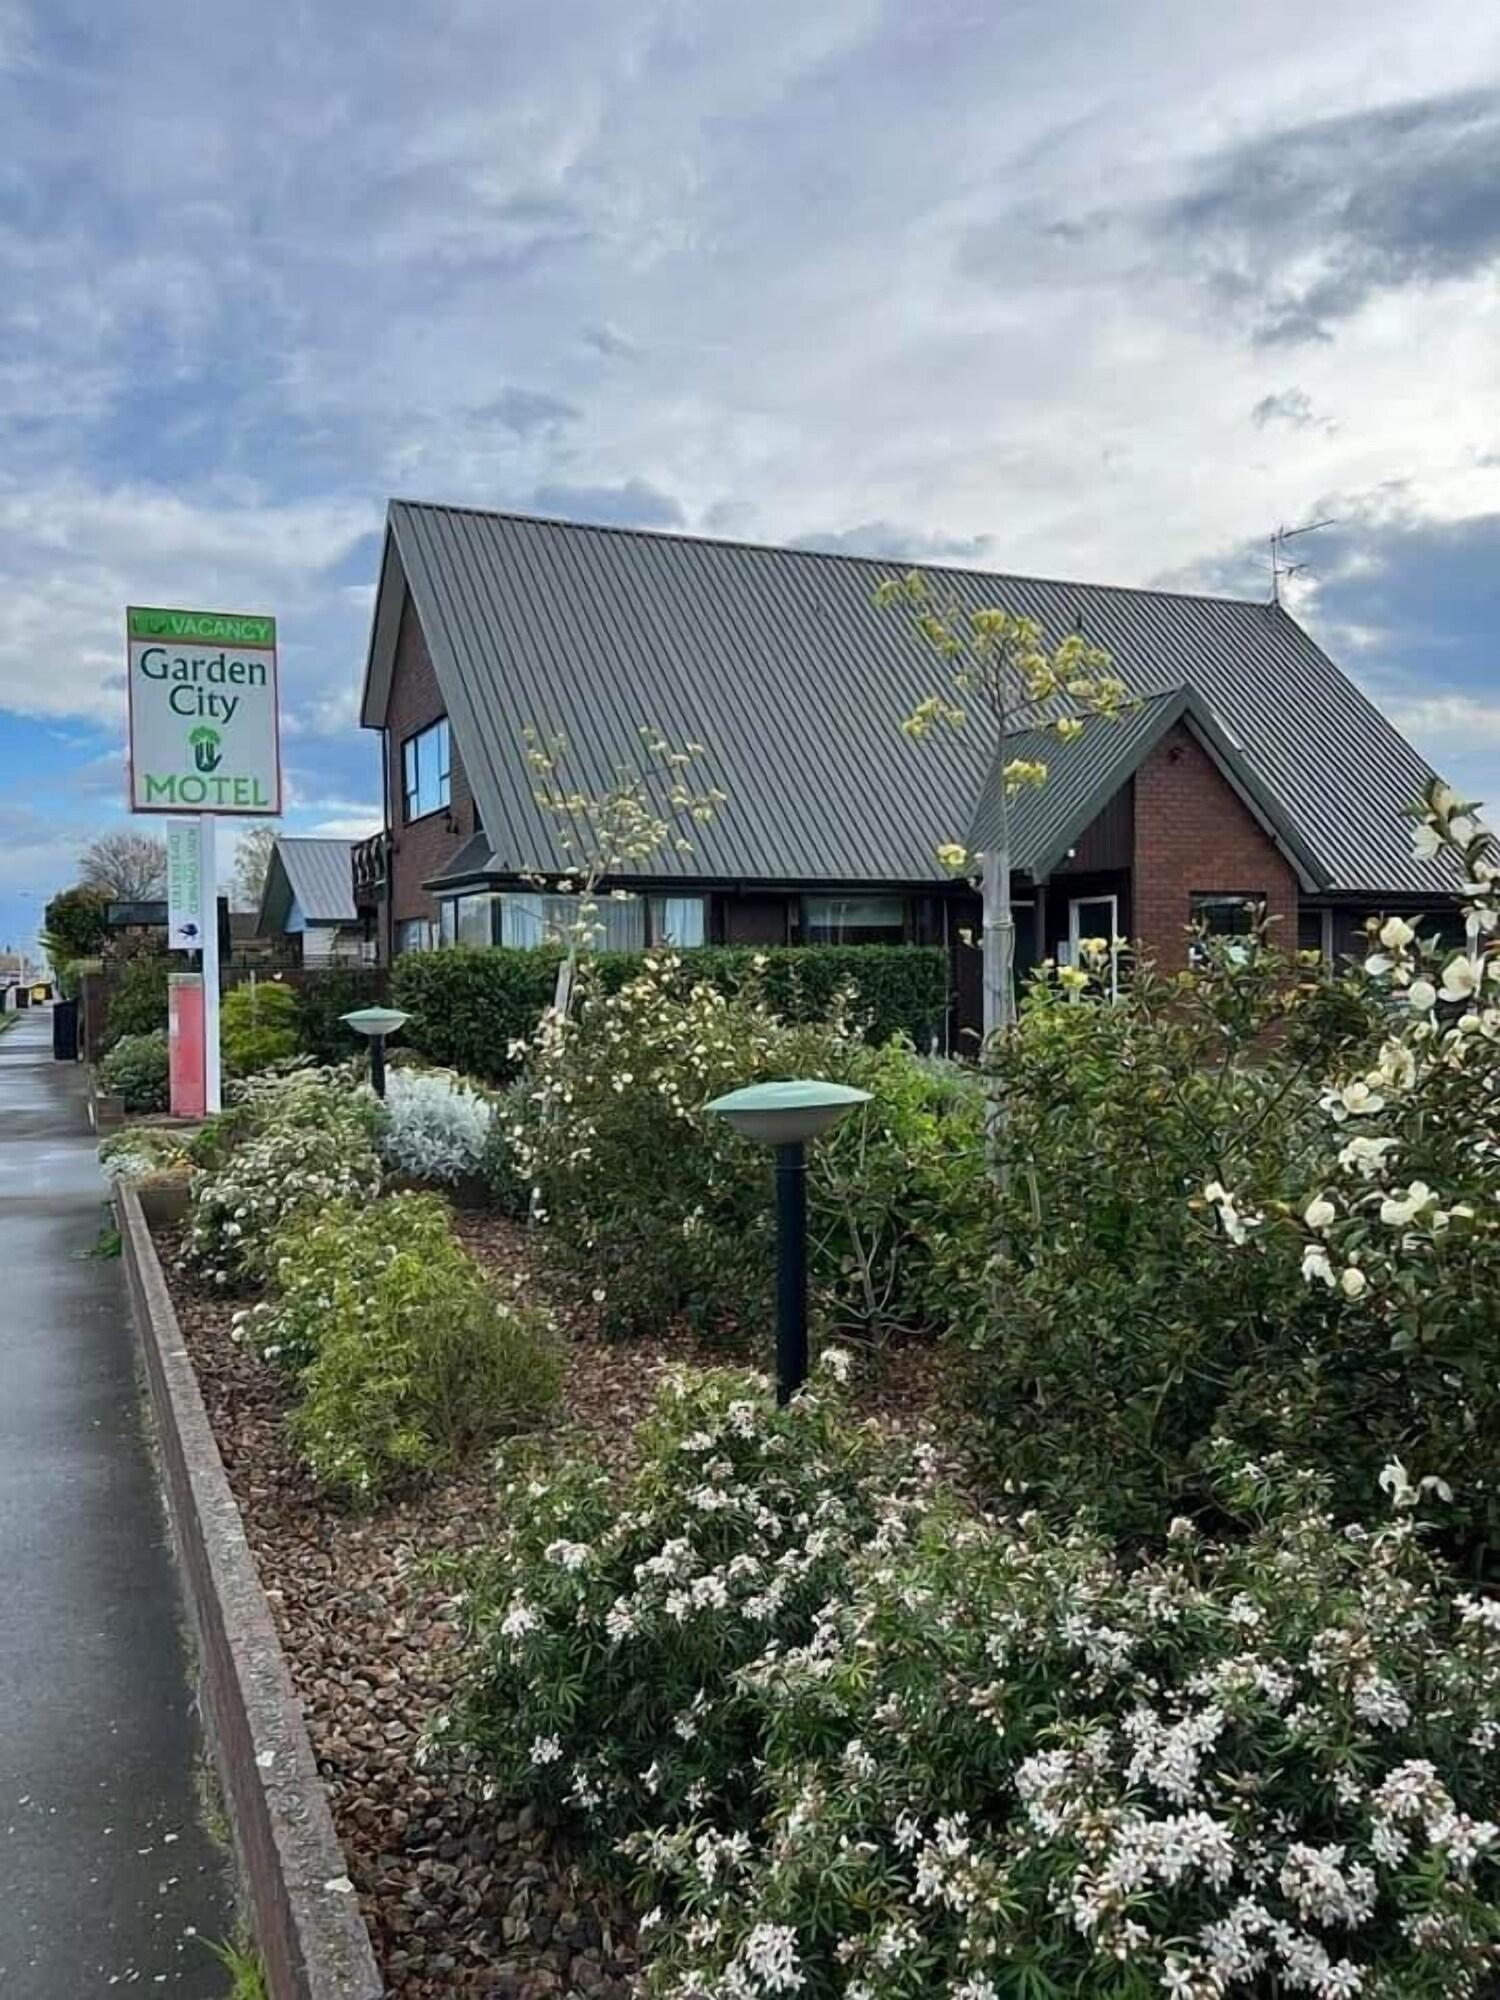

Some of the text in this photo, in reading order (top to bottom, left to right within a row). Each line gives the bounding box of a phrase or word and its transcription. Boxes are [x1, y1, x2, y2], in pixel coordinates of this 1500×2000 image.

[170, 615, 269, 641] VACANCY
[140, 648, 267, 685] Garden
[169, 684, 239, 724] City
[144, 774, 268, 805] MOTEL
